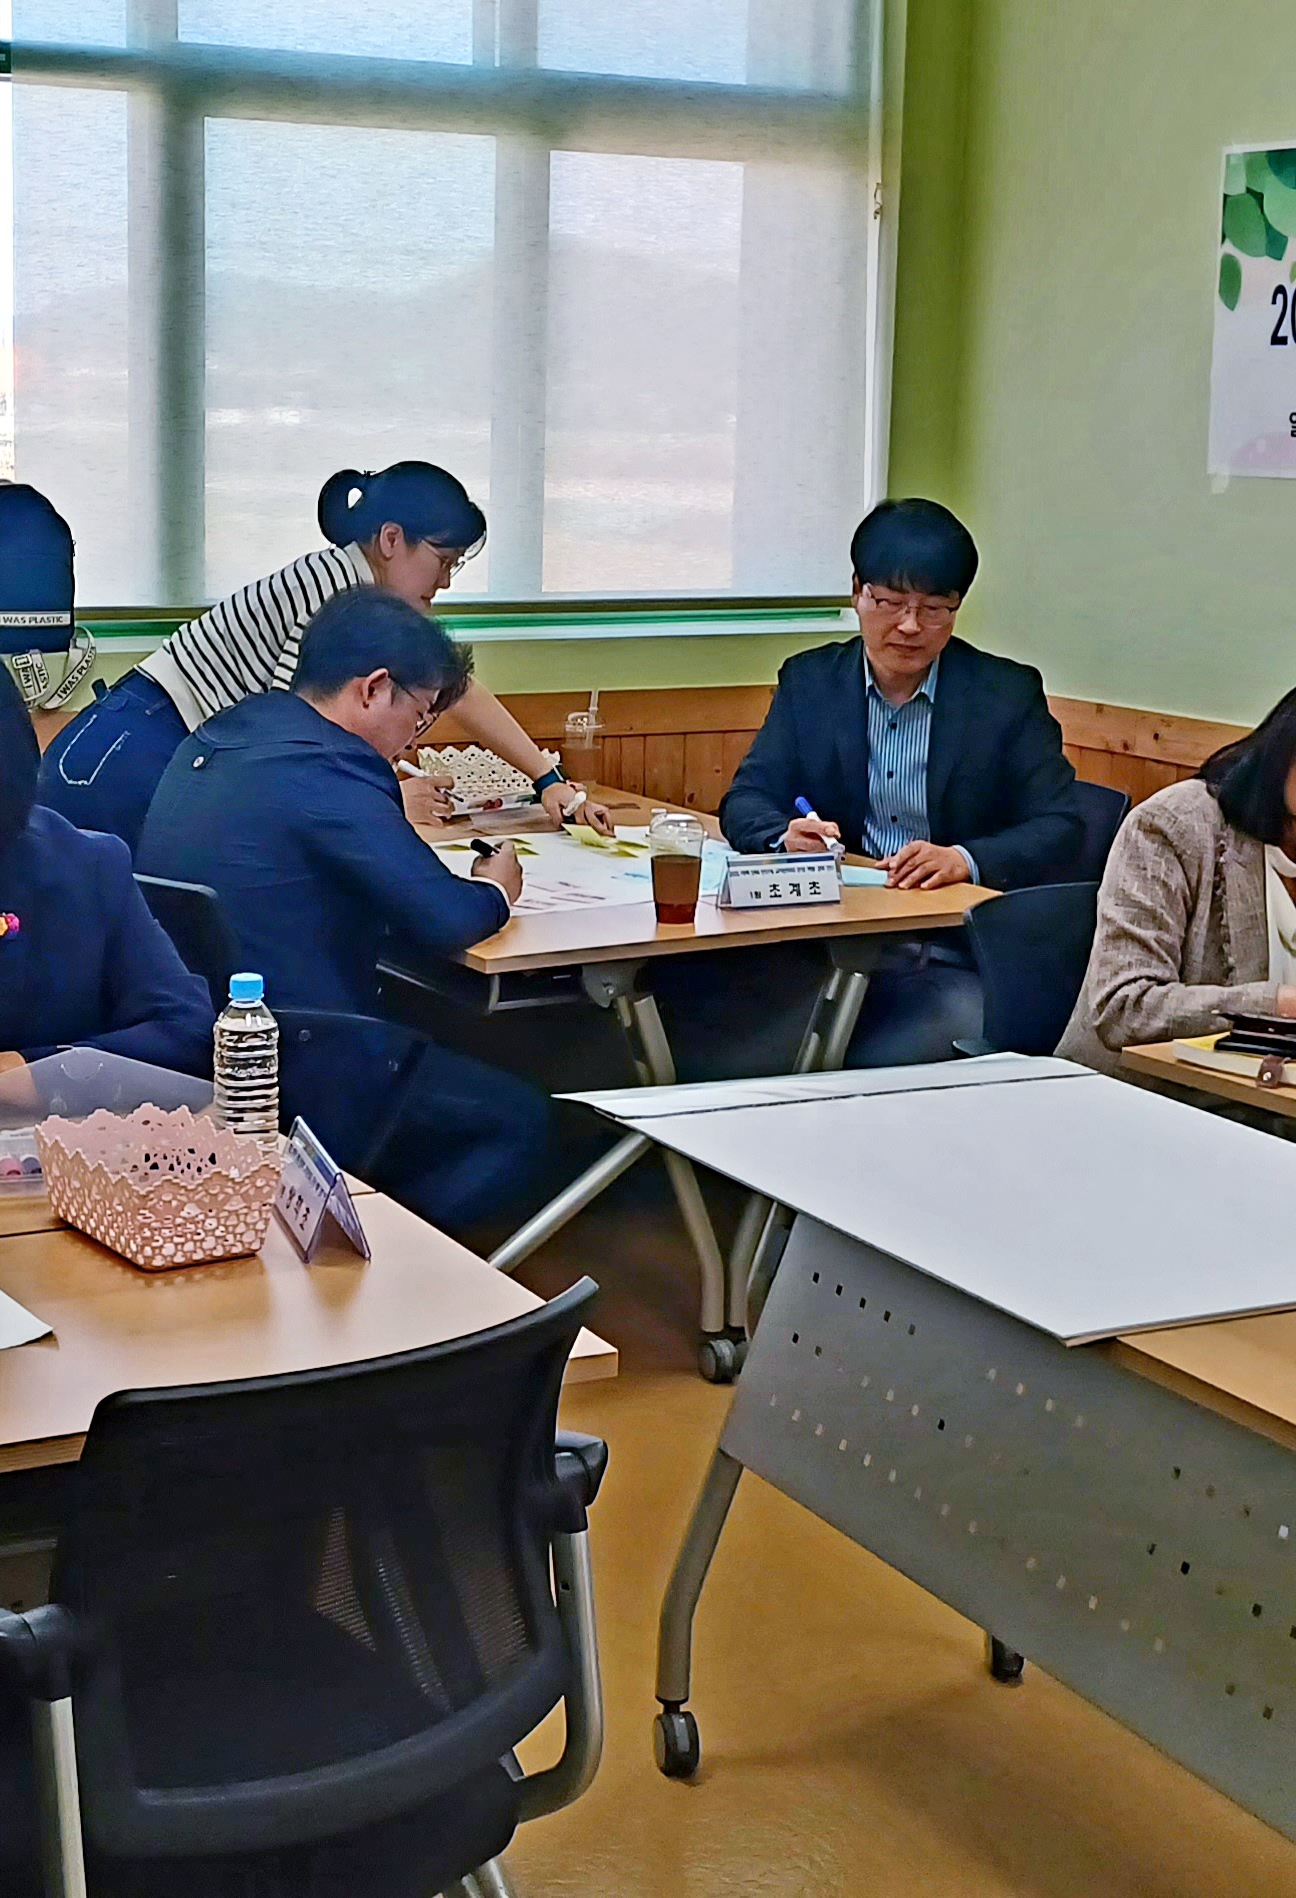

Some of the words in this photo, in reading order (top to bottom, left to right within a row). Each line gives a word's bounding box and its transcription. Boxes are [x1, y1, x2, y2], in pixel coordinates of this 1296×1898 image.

[2, 616, 26, 624] WAS
[28, 615, 64, 624] PLASTIC
[59, 676, 79, 696] WAS
